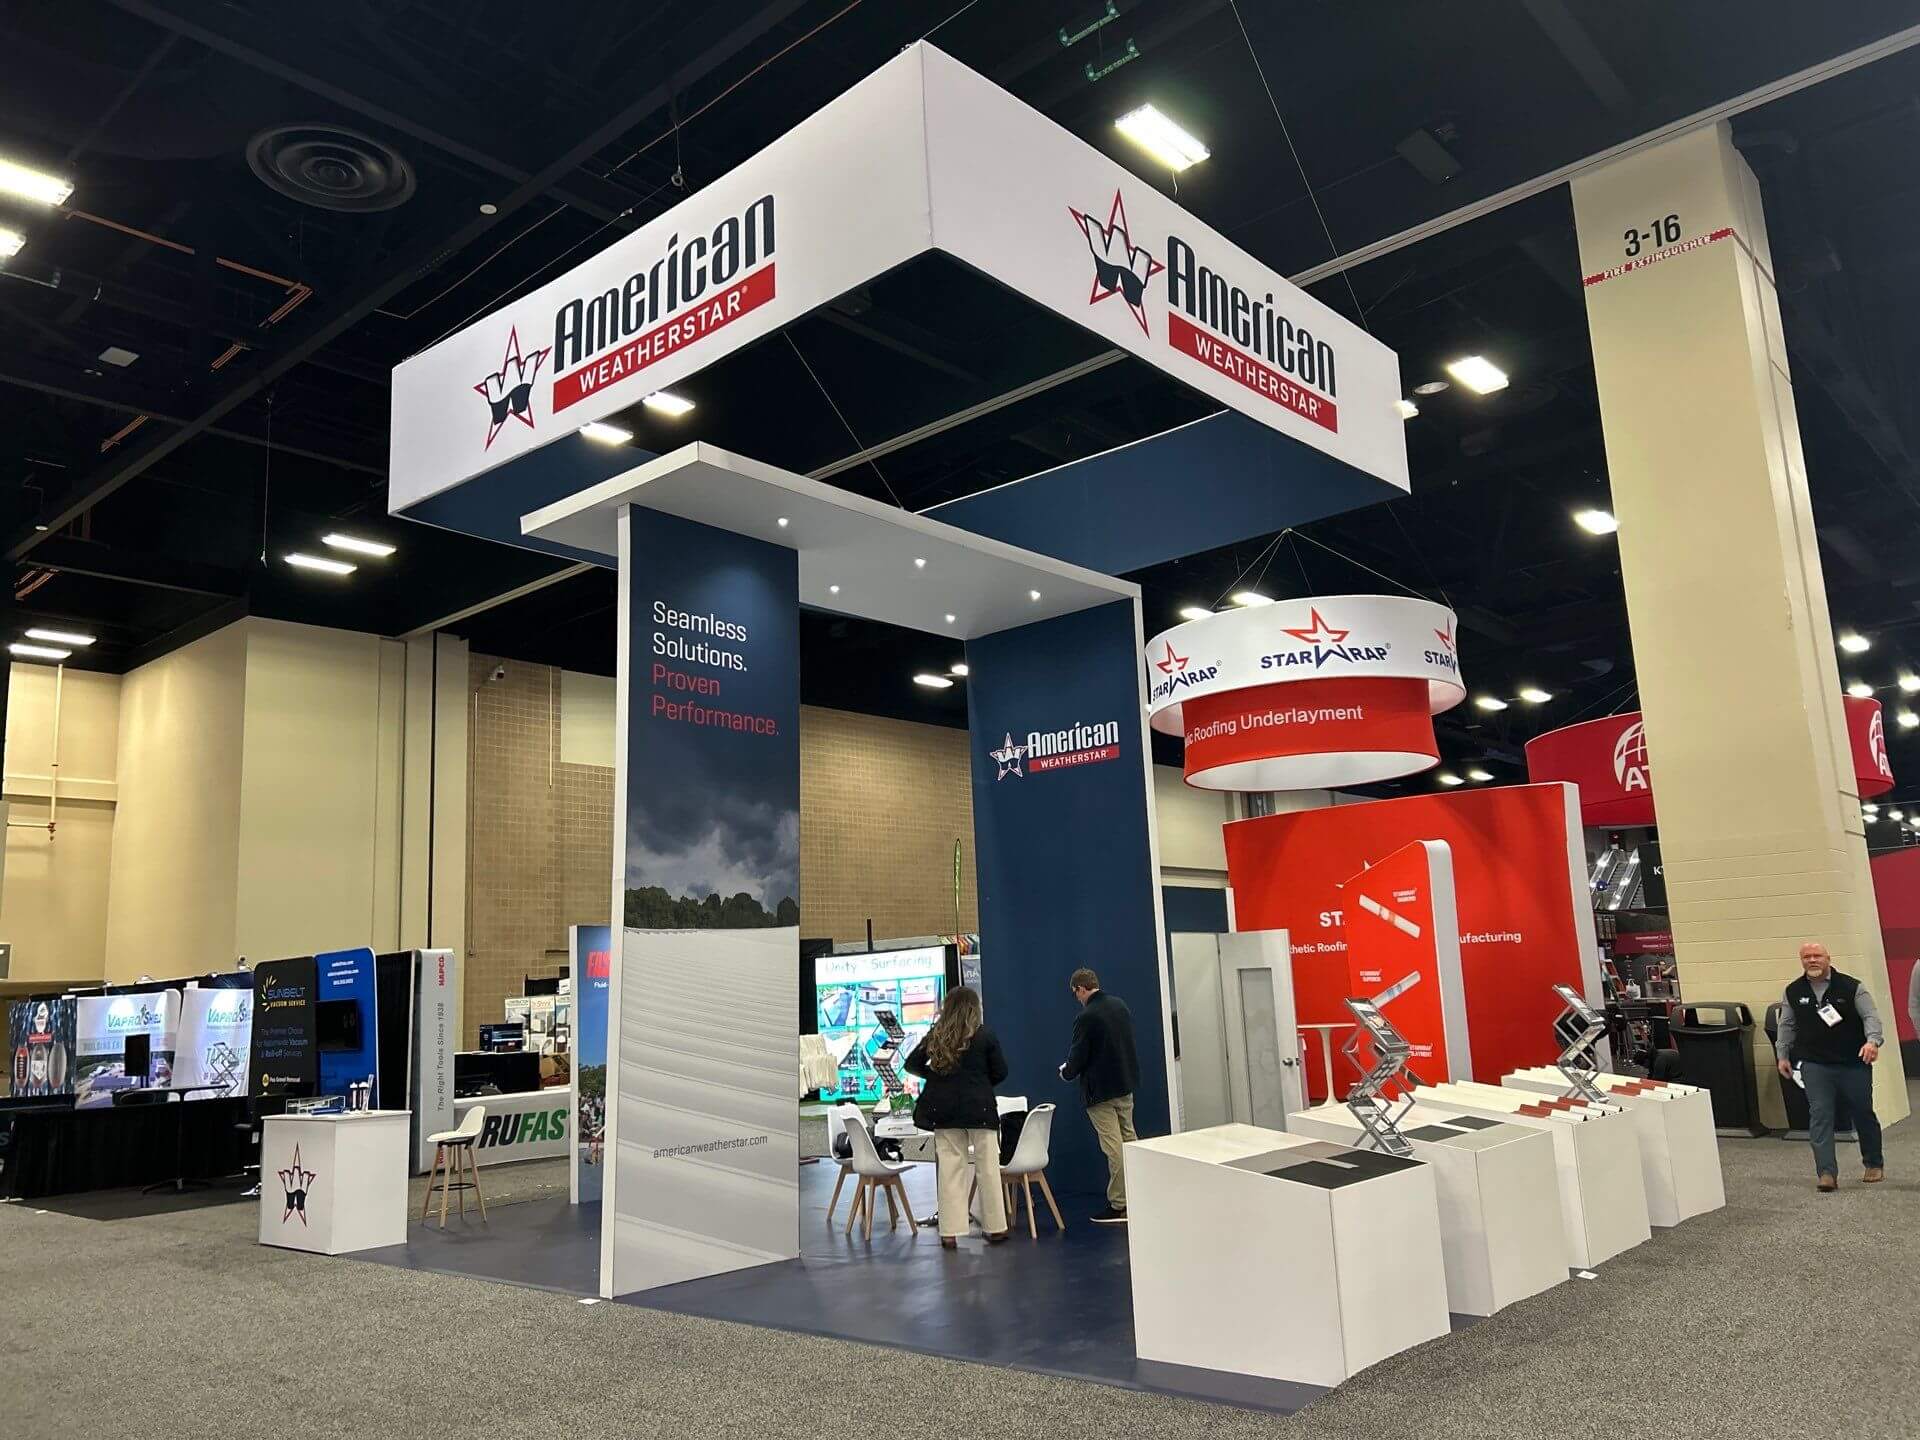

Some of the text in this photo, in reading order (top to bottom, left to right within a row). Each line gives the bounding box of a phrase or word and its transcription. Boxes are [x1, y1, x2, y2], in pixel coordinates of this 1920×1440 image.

[1624, 214, 1682, 257] 3-16
[1603, 234, 1713, 280] FIRE EXTINGUISHER
[554, 194, 776, 375] American
[1167, 235, 1337, 398] American
[652, 600, 748, 643] Seamless
[652, 632, 749, 672] Solutions.
[652, 663, 721, 697] Proven
[652, 694, 781, 737] Performance.
[1194, 719, 1237, 743] Roofing
[1241, 705, 1364, 731] Underlayment
[1027, 720, 1120, 759] American
[1319, 910, 1346, 928] ST
[437, 1023, 445, 1046] Since
[437, 1048, 445, 1069] Tools
[437, 1071, 446, 1093] Right
[437, 1094, 445, 1112] The
[477, 1109, 571, 1150] RUFAS
[653, 1135, 768, 1159] americanweatherstar.com
